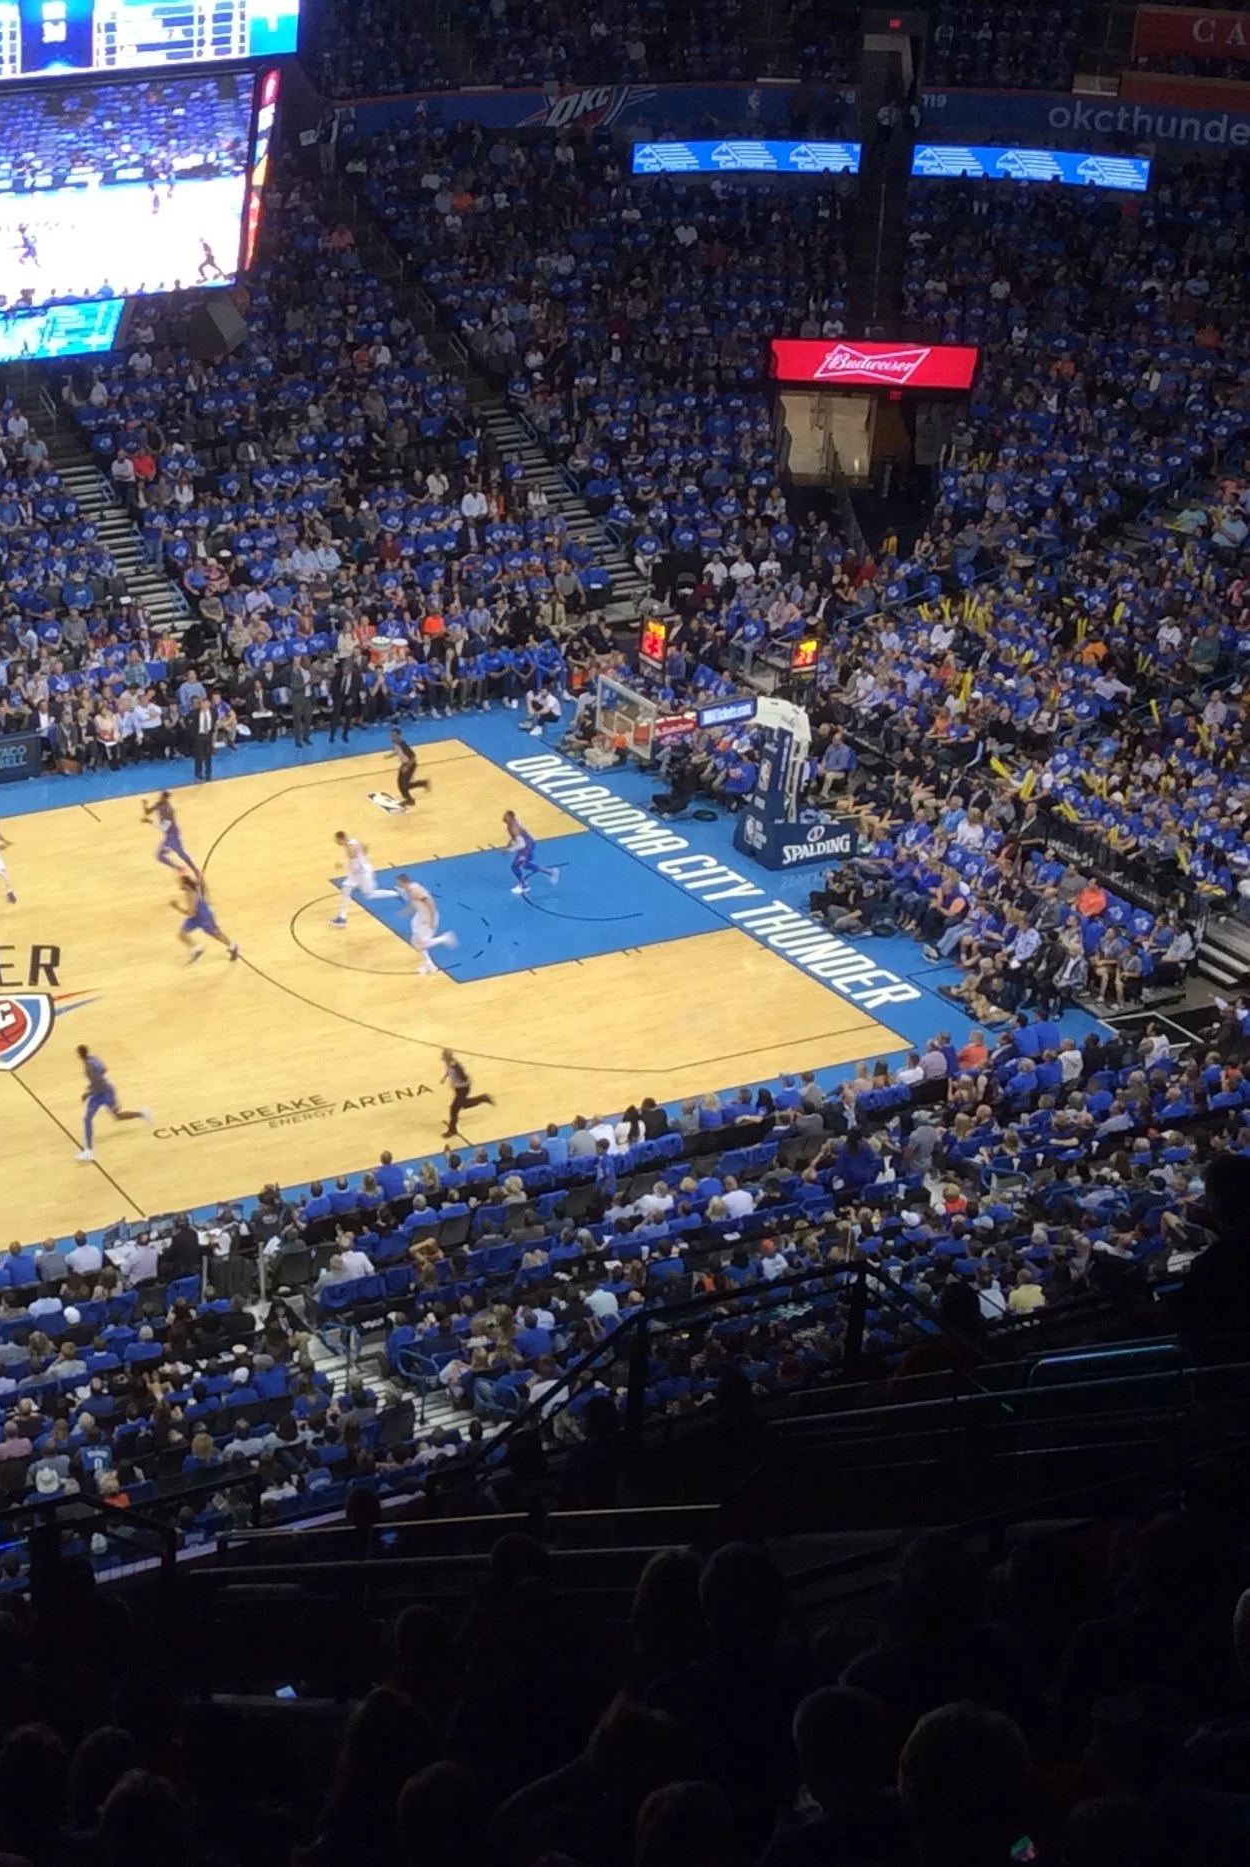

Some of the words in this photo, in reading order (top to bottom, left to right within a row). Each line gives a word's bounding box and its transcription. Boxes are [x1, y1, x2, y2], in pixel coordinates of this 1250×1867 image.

[922, 94, 947, 108] 119
[825, 351, 915, 371] Budweiser
[782, 833, 850, 865] SPALDING
[506, 754, 689, 855] OKLAHOMA
[657, 854, 765, 901] CITY
[730, 900, 922, 1010] THUNDER
[152, 1094, 328, 1140] CHESAPEAKE
[341, 1084, 434, 1113] ARENA
[268, 1108, 336, 1129] ENERGY
